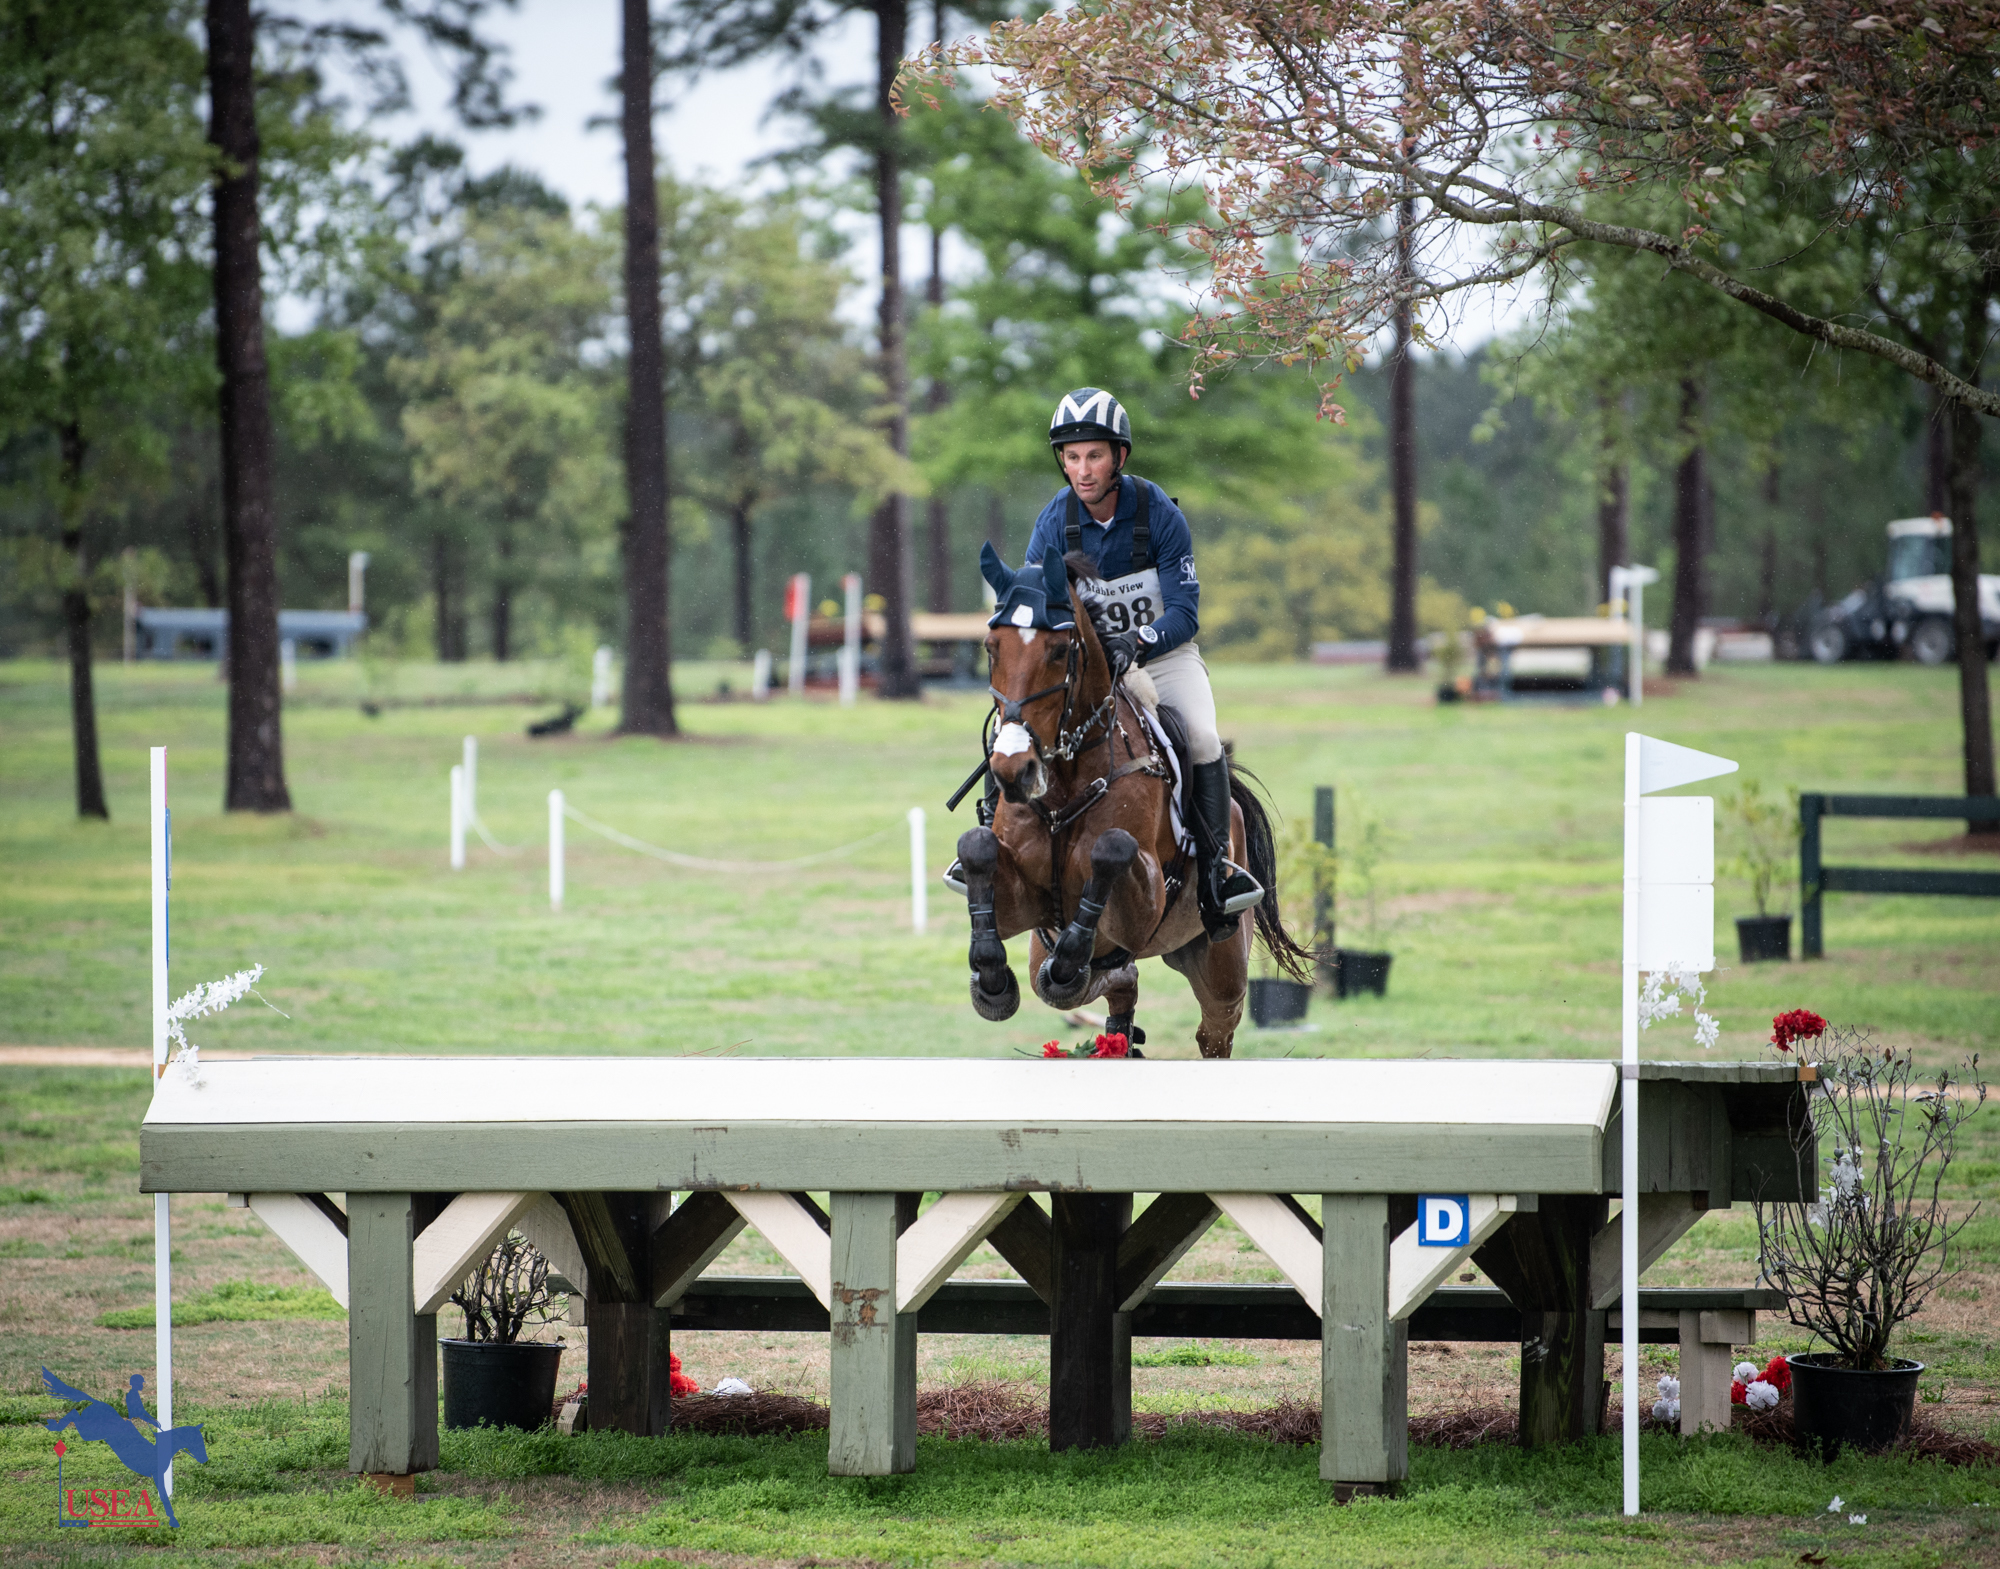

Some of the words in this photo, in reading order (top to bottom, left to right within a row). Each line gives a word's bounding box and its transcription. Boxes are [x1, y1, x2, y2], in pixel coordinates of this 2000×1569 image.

[1118, 582, 1144, 594] View
[1106, 596, 1155, 633] 98
[1425, 1198, 1463, 1241] D
